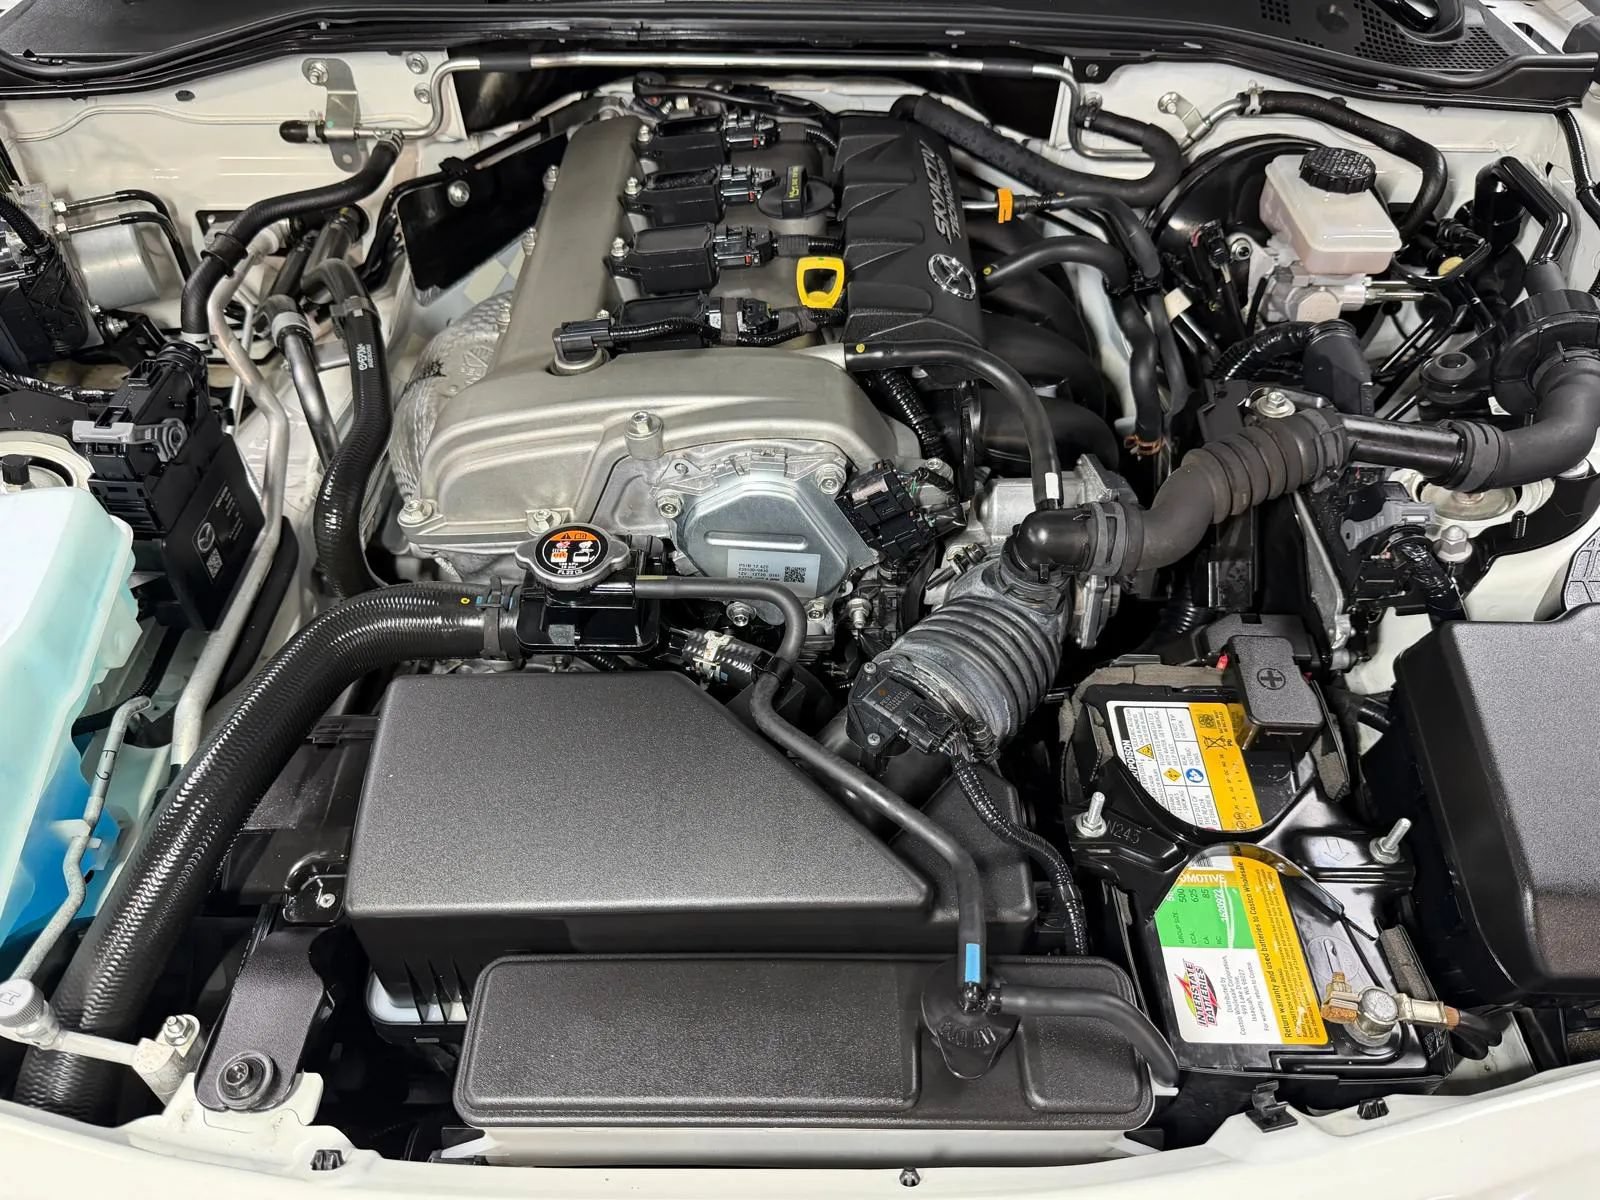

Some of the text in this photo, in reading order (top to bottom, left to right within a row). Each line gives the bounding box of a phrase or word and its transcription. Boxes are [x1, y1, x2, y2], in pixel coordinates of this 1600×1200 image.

[919, 140, 952, 244] SKYACTIV
[936, 153, 961, 238] TECHNOLOGY
[1238, 861, 1251, 892] Wholesale
[1177, 888, 1187, 902] 500
[1201, 888, 1210, 898] 85
[1247, 893, 1256, 914] Costco
[1189, 888, 1210, 944] CA 625
[1255, 924, 1268, 951] batteries
[1264, 953, 1272, 968] used
[1186, 962, 1208, 1026] INTERSTATE
[1195, 968, 1216, 1024] BATTERIES
[1222, 983, 1233, 1012] Distributed
[1230, 988, 1241, 1014] Wholesale
[1273, 984, 1286, 1013] warranty
[1237, 1015, 1246, 1035] Costco
[1281, 1014, 1292, 1037] Return
